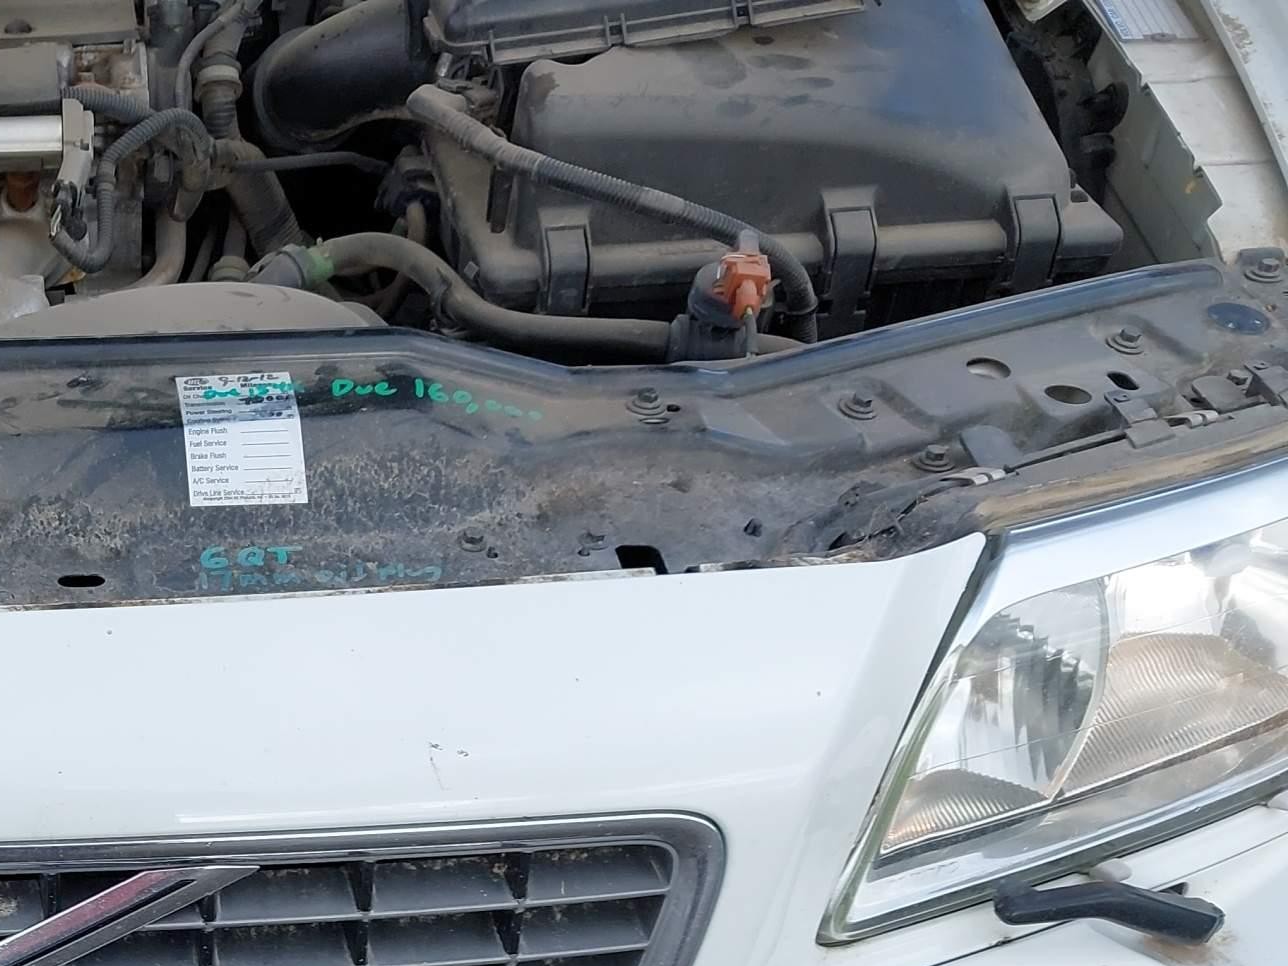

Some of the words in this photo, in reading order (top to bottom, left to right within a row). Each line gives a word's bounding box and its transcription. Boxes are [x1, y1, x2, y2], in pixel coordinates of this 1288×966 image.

[331, 378, 398, 397] Due
[188, 428, 210, 436] Engine
[192, 465, 213, 473] Battery
[200, 546, 229, 569] 6
